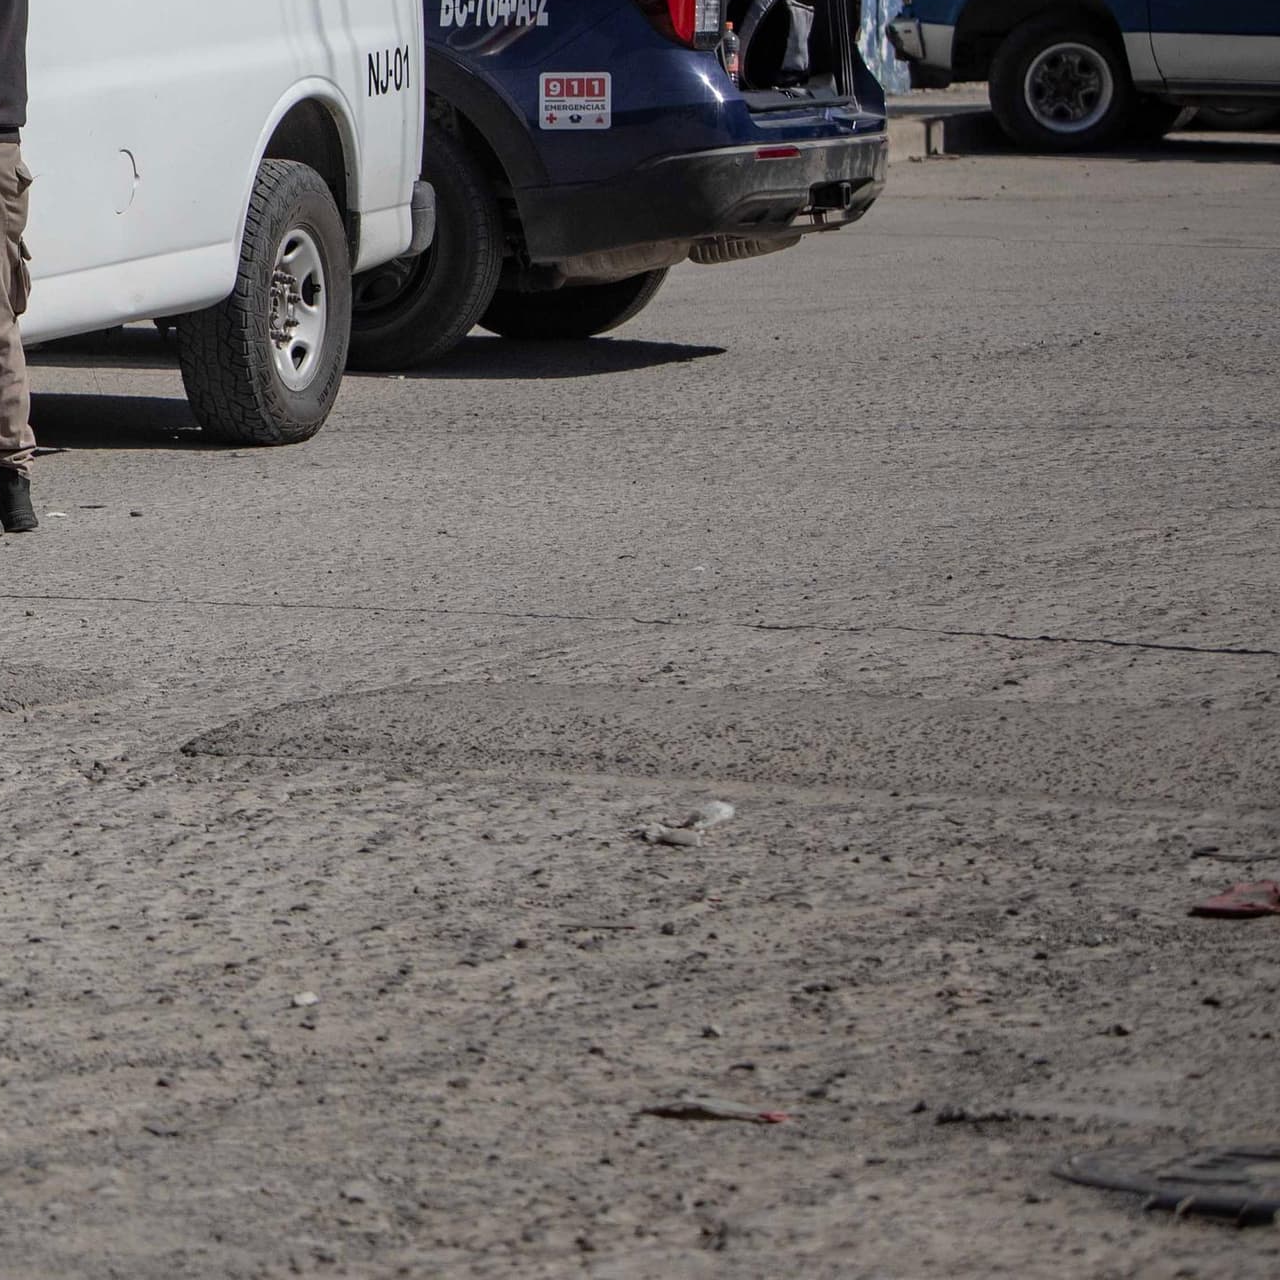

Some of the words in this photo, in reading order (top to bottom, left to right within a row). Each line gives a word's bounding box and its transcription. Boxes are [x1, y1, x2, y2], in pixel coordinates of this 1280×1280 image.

[367, 45, 411, 97] NJ-01
[547, 79, 601, 96] 911
[544, 103, 606, 112] EMERGENCIAS
